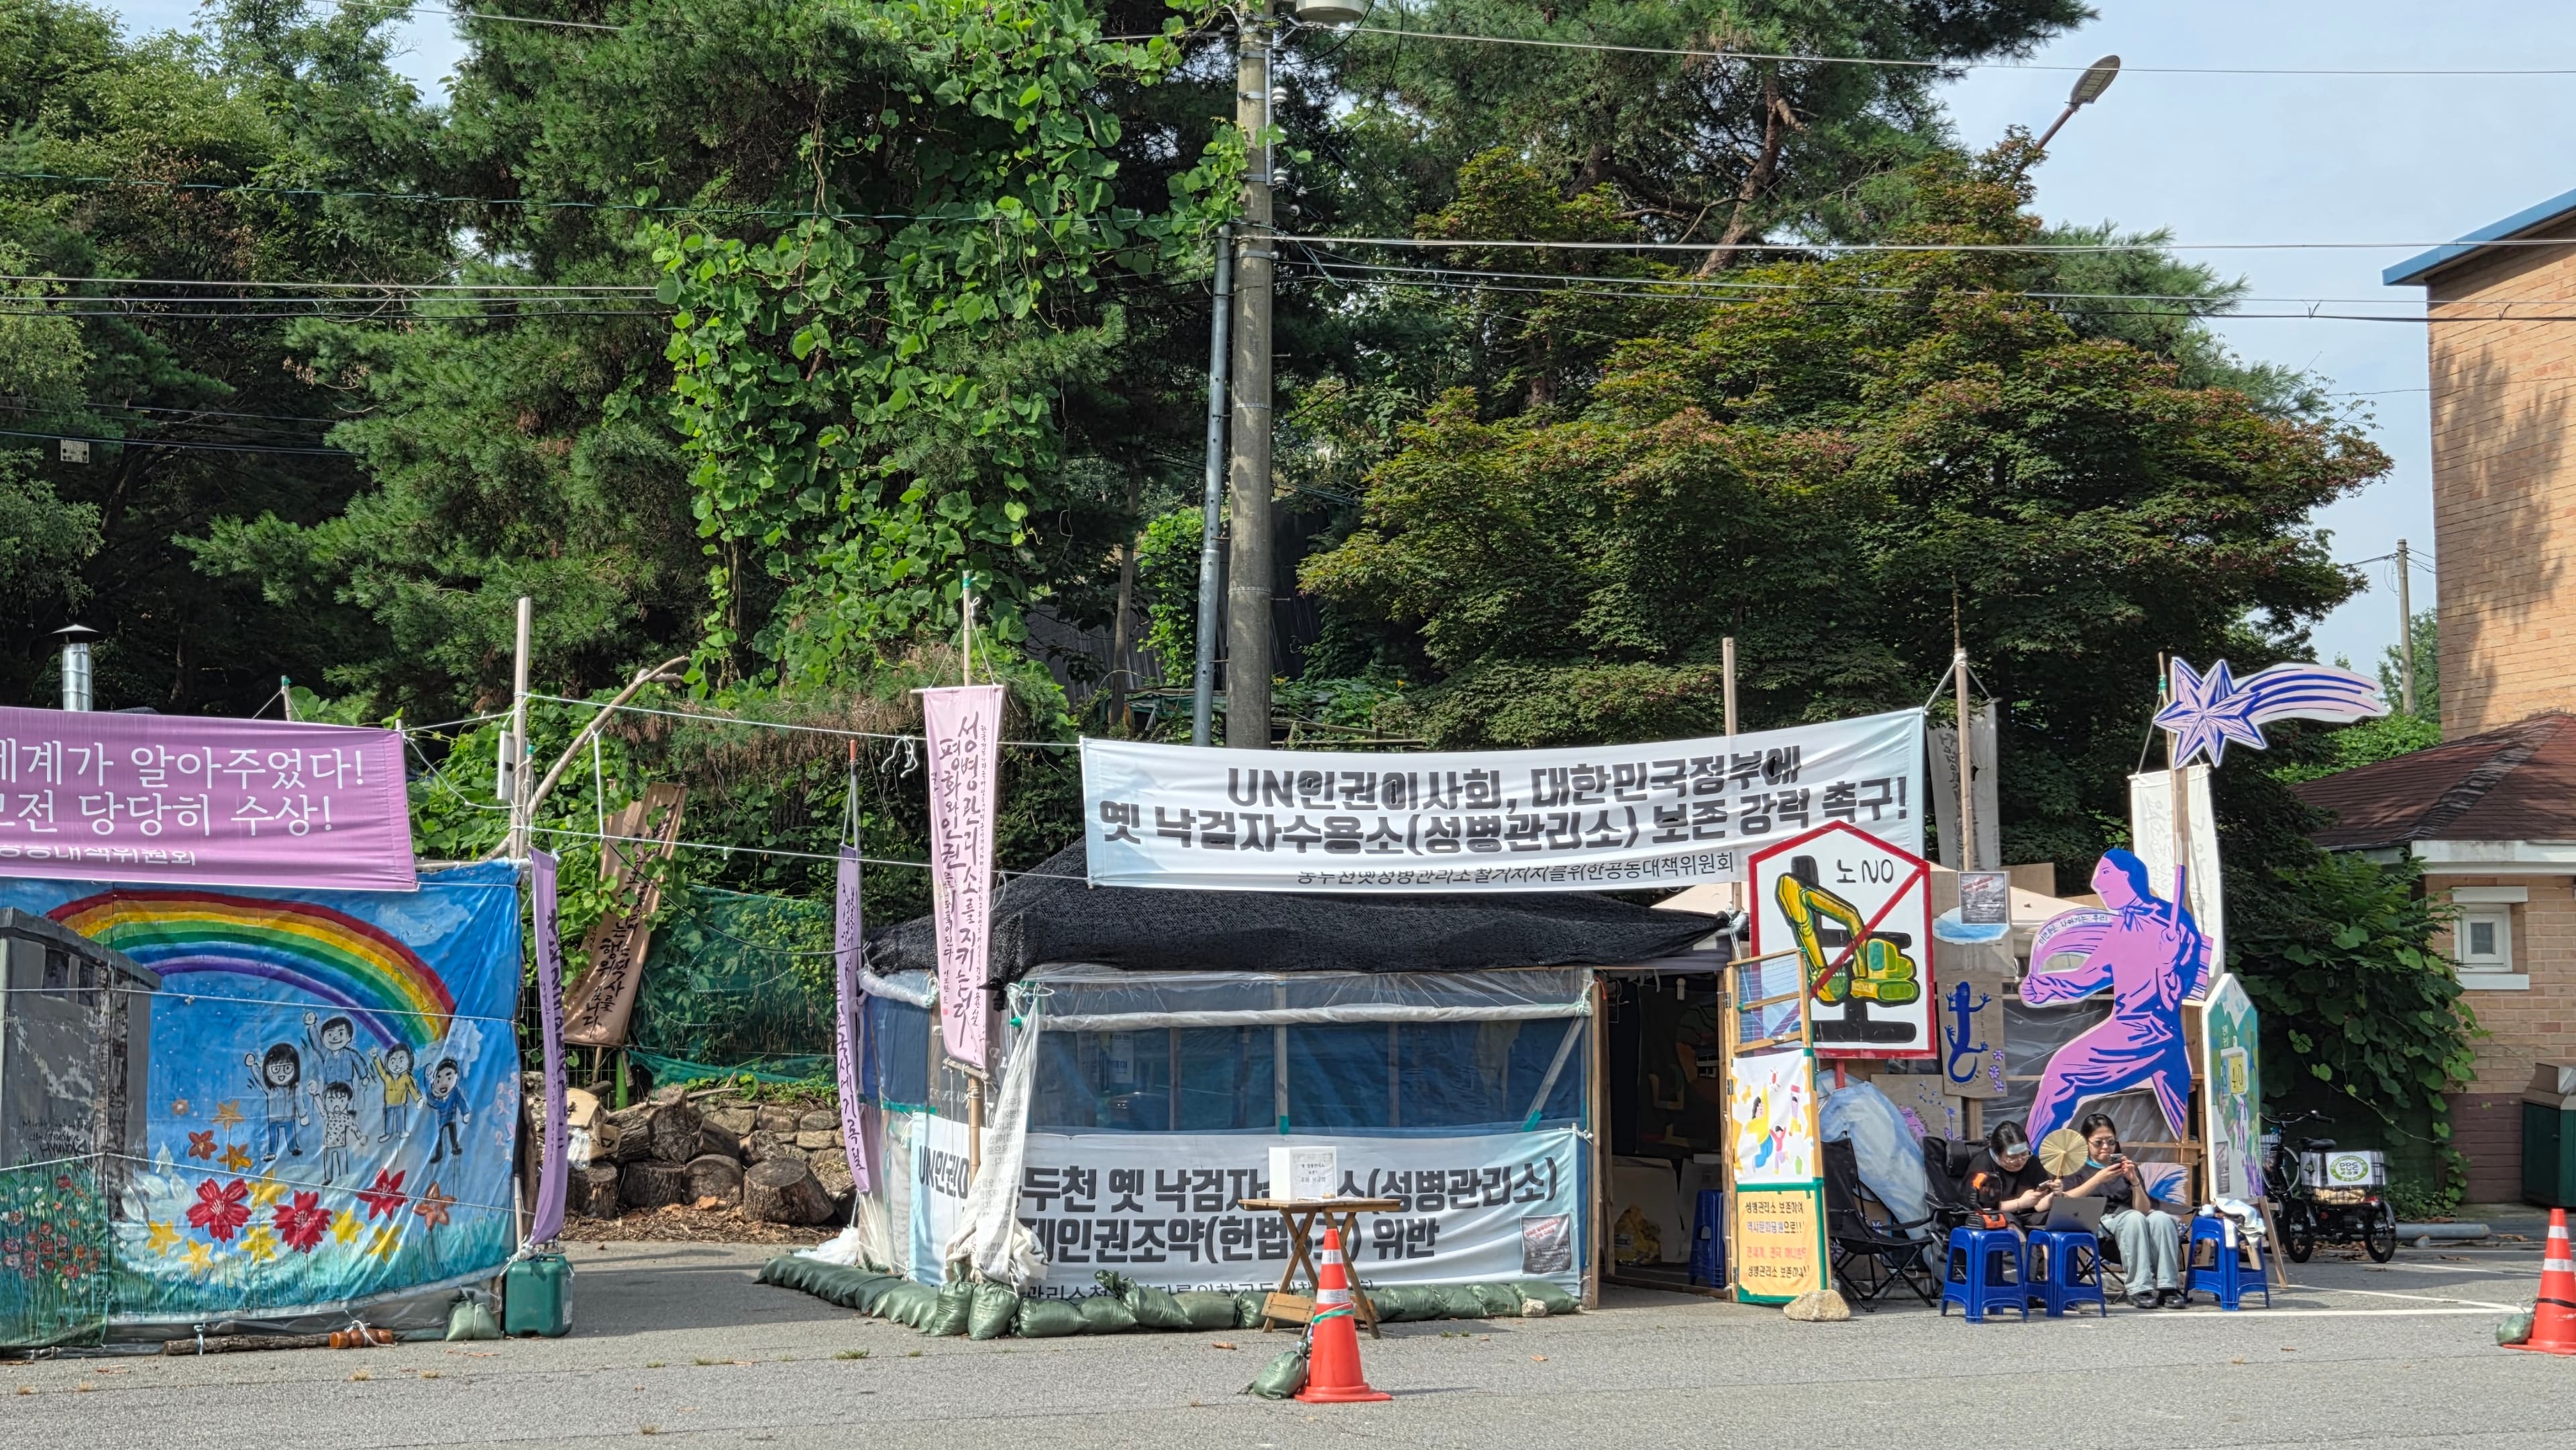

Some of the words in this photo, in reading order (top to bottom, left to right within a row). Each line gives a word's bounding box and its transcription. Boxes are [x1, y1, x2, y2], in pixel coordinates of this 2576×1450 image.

[131, 742, 364, 790] 알아주었다!
[1228, 767, 1518, 814] UN인권이사회,
[1530, 744, 1802, 808] 대한민국정부에
[78, 791, 210, 836] 당당히
[231, 795, 333, 836] 수상!
[1099, 800, 1140, 844] 옛
[1155, 805, 1639, 856] 낙검자수용소(성병관리소)
[1652, 799, 1729, 844] 보존
[1740, 787, 1810, 836] 강력
[1821, 776, 1907, 824] 촉구!
[1017, 1166, 1096, 1212] 두천
[1109, 1169, 1144, 1213] 옛
[1373, 1217, 1440, 1260] 위반
